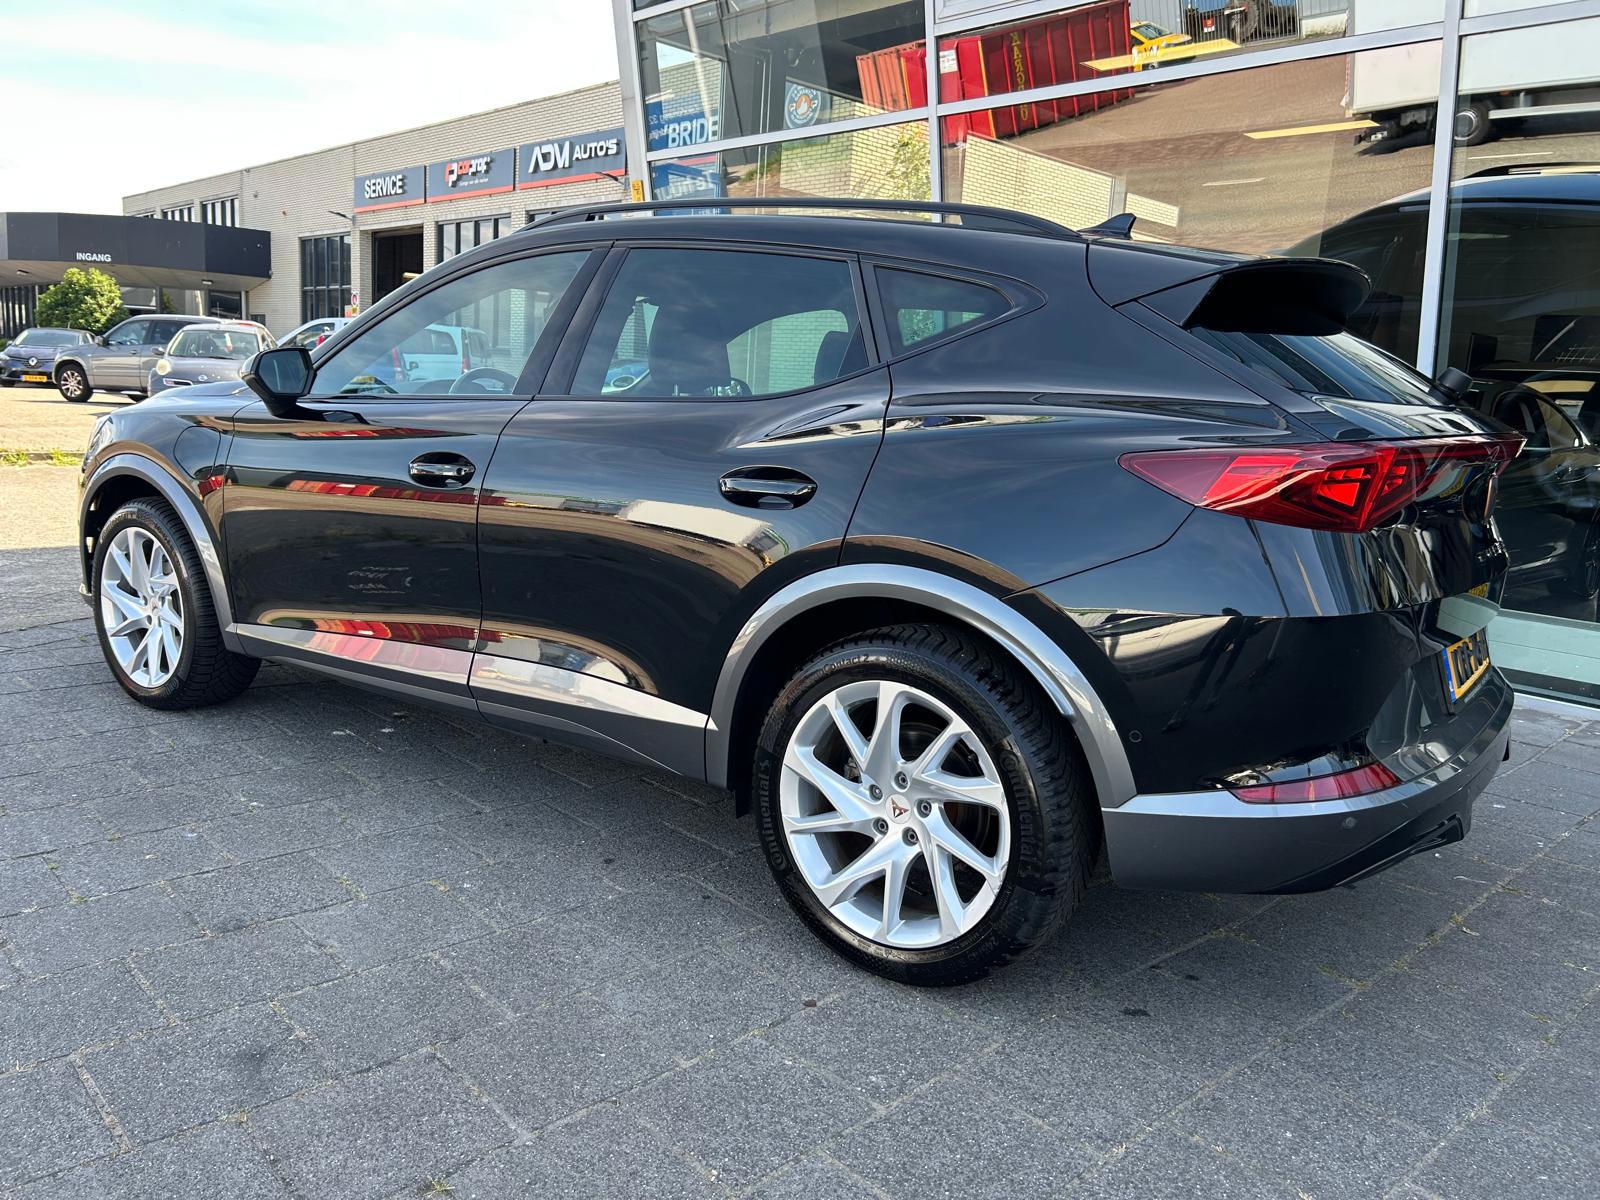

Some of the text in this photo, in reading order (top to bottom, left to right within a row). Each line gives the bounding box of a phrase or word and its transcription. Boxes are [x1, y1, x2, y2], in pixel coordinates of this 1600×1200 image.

[528, 138, 618, 173] ADM AUTO'S
[364, 174, 404, 199] SERVICE
[76, 252, 112, 263] INGANG
[759, 773, 787, 871] Continental
